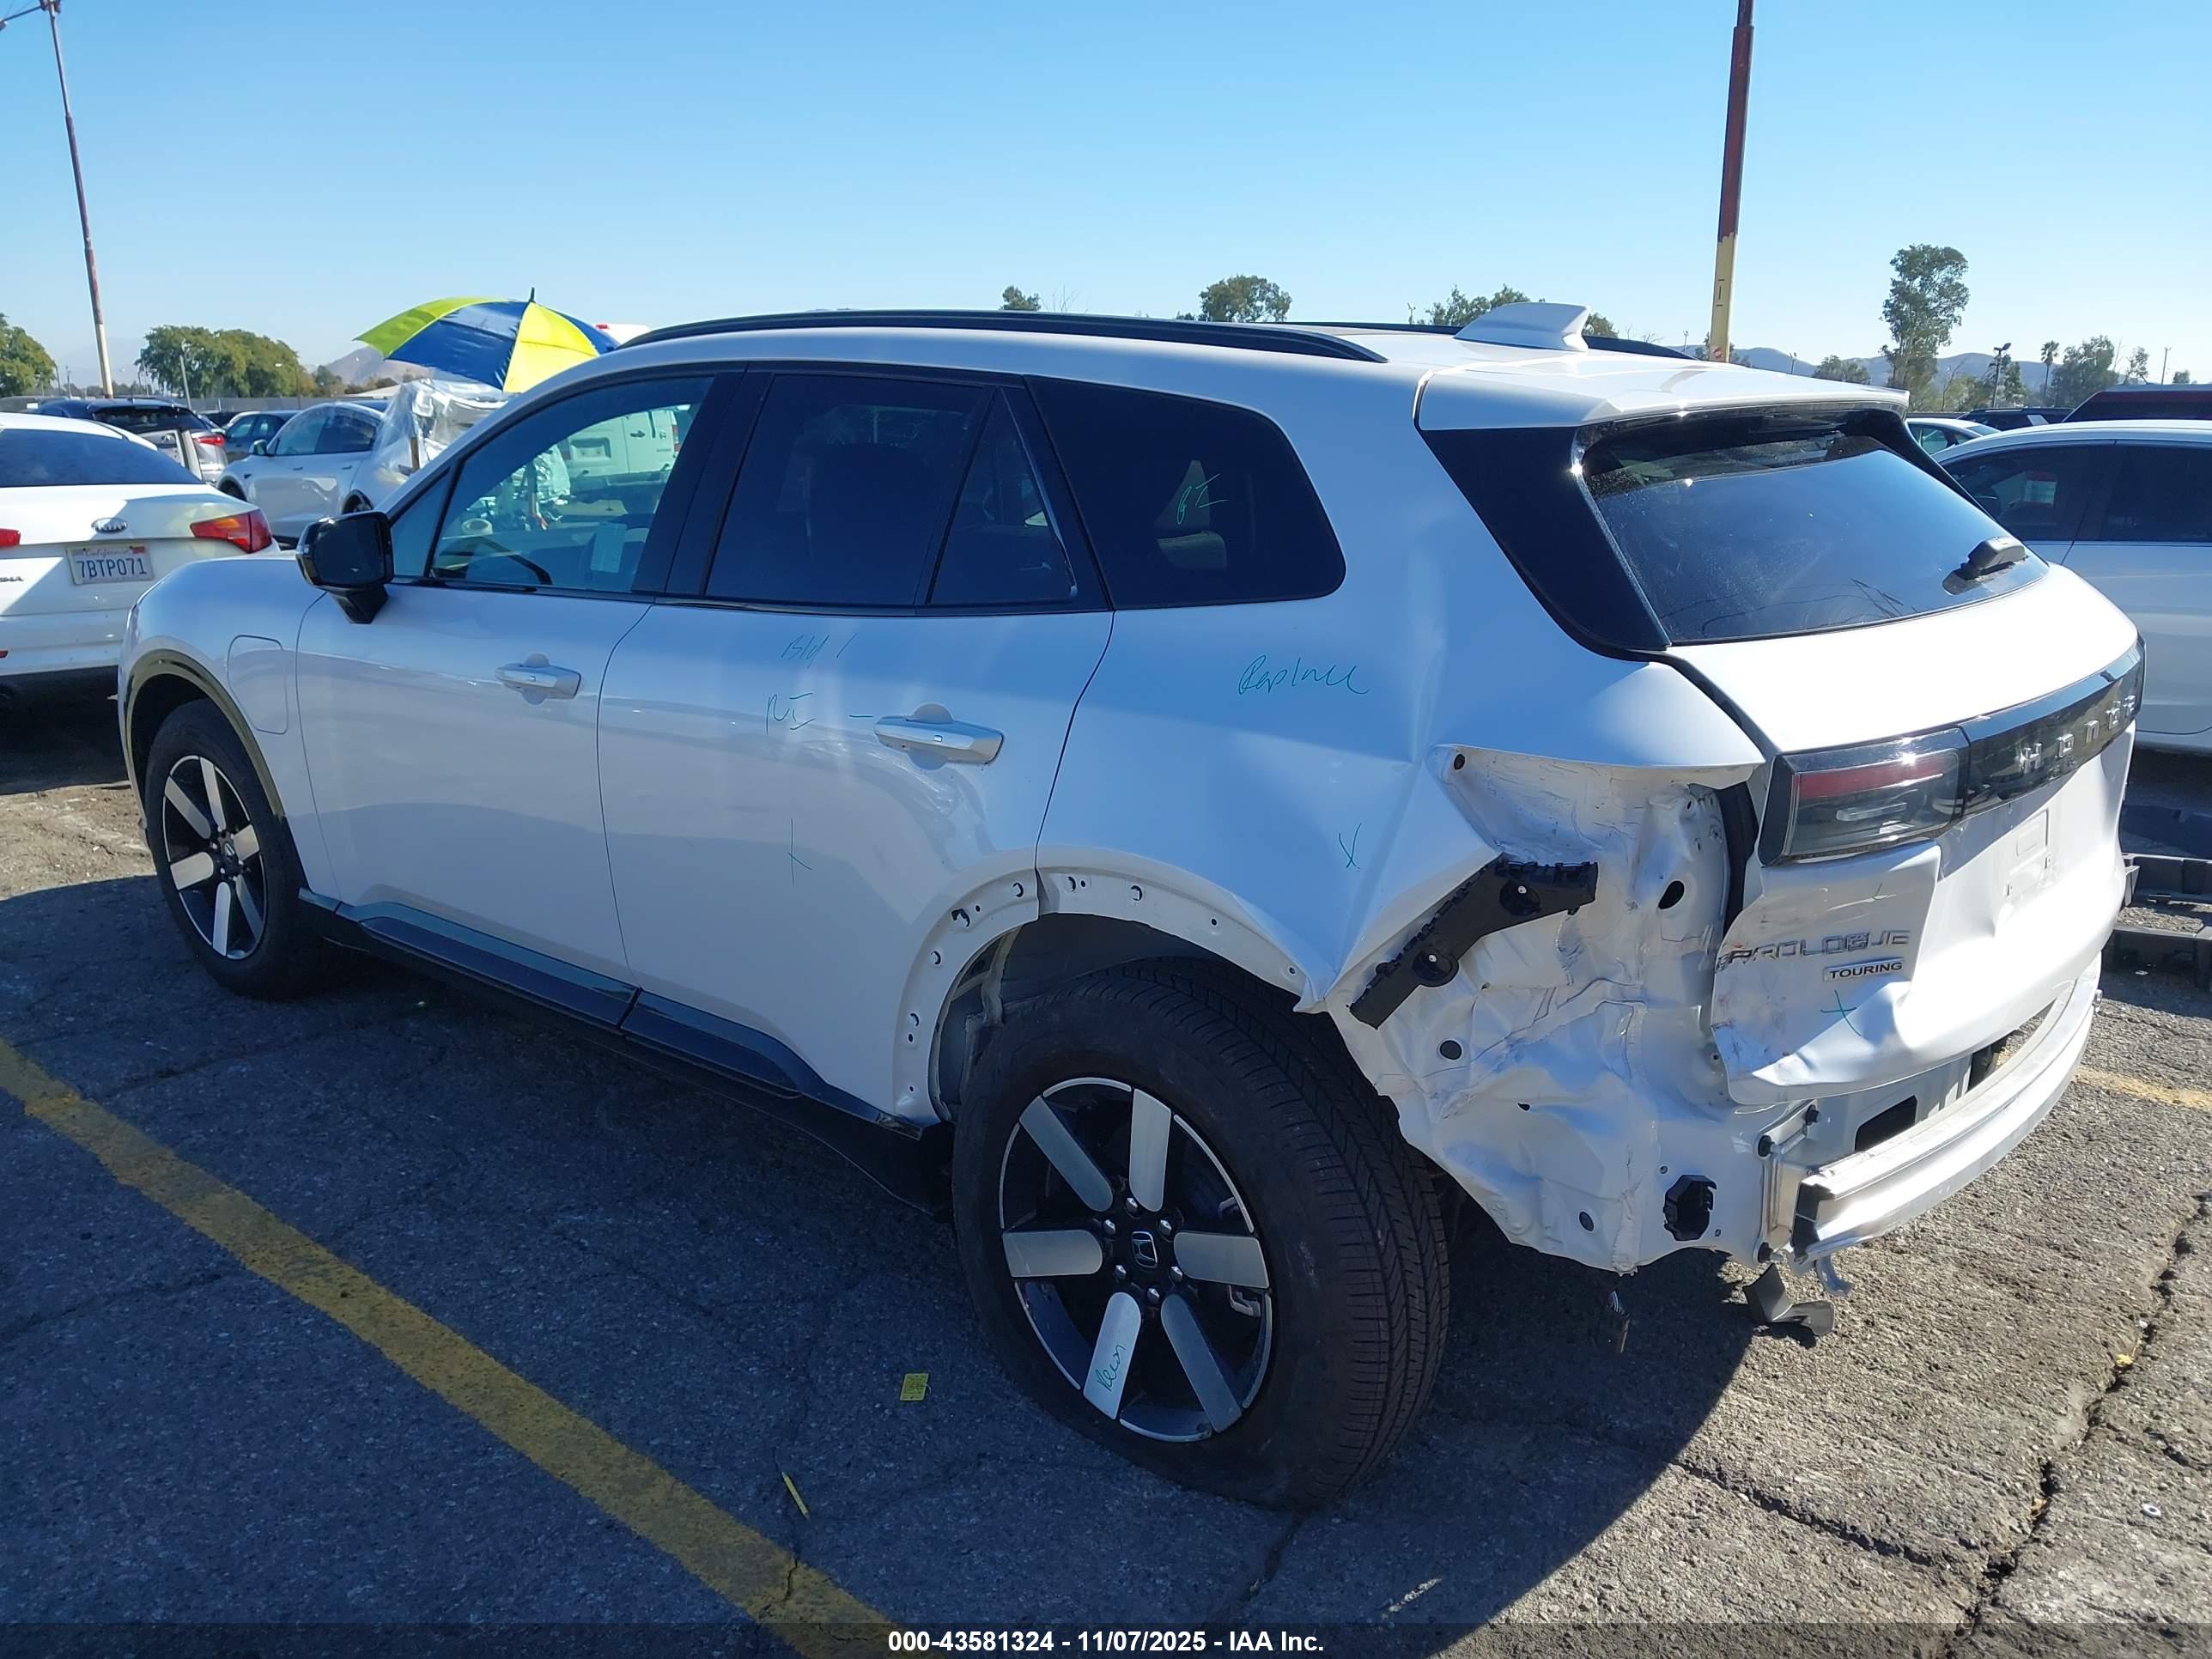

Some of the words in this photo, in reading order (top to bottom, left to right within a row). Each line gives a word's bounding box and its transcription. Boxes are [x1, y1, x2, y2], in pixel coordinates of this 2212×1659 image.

[76, 558, 148, 578] 7BTP071
[1717, 930, 1911, 974] PROLOGUE
[1830, 962, 1903, 979] TOURING
